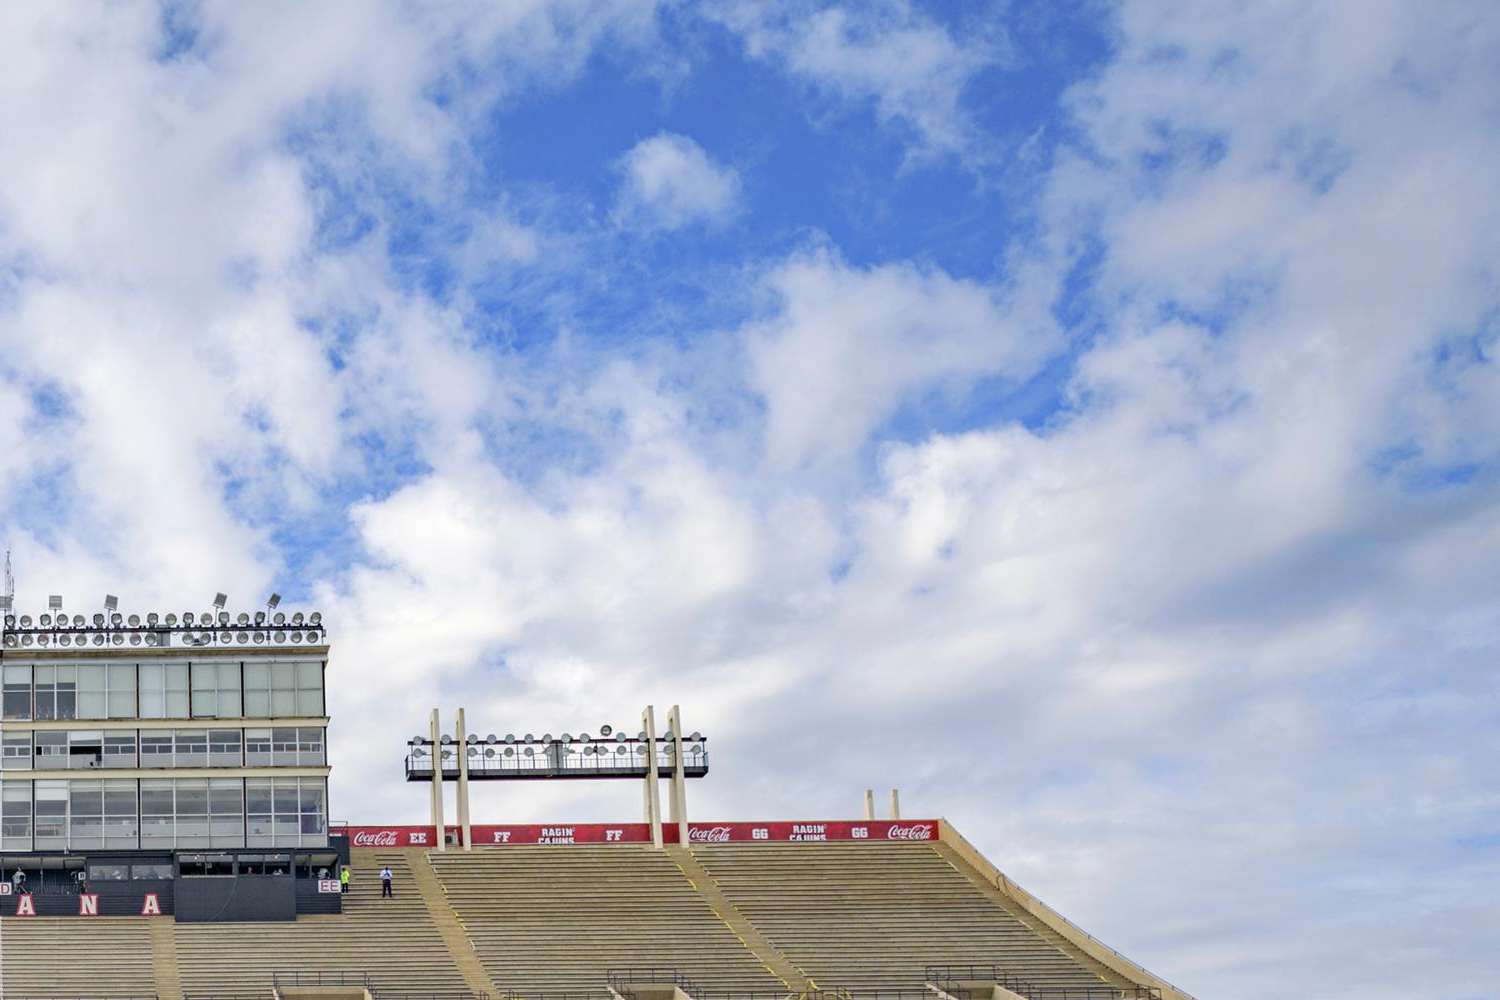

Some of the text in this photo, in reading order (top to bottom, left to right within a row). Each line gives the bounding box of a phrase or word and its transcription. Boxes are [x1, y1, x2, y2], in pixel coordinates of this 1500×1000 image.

[353, 830, 397, 846] Coca-Cola
[409, 832, 427, 844] EE
[493, 831, 511, 843] FF
[606, 829, 624, 842] FF
[752, 828, 769, 840] GG
[851, 827, 869, 839] GG
[887, 824, 933, 841] Coca-Cola
[320, 880, 340, 892] EE
